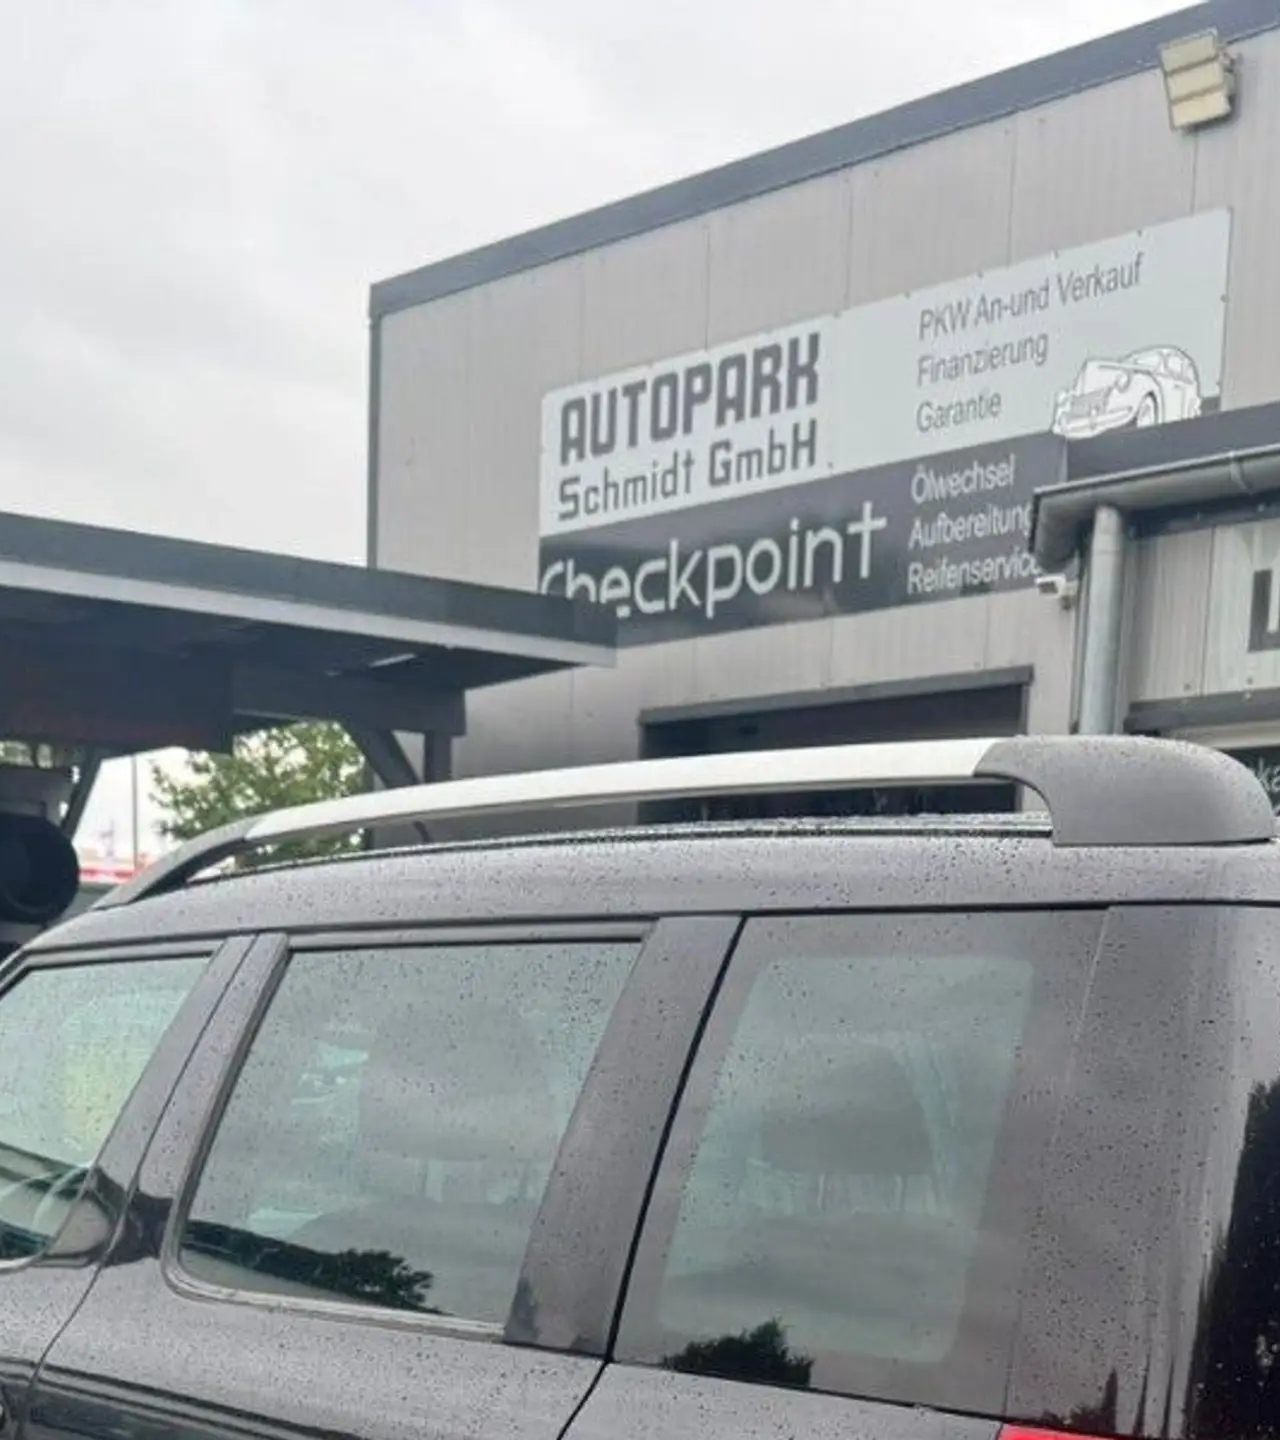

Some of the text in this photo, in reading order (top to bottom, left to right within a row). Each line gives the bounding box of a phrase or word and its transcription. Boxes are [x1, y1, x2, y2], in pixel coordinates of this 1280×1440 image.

[919, 299, 970, 342] PKW
[1056, 250, 1145, 307] Verkauf
[917, 333, 1049, 388] Finanzierung
[560, 331, 821, 467] AUTOPARK
[916, 392, 1003, 433] Garantie
[558, 418, 818, 522] Schmidt GmbH
[910, 453, 1016, 504] Ölwechsel
